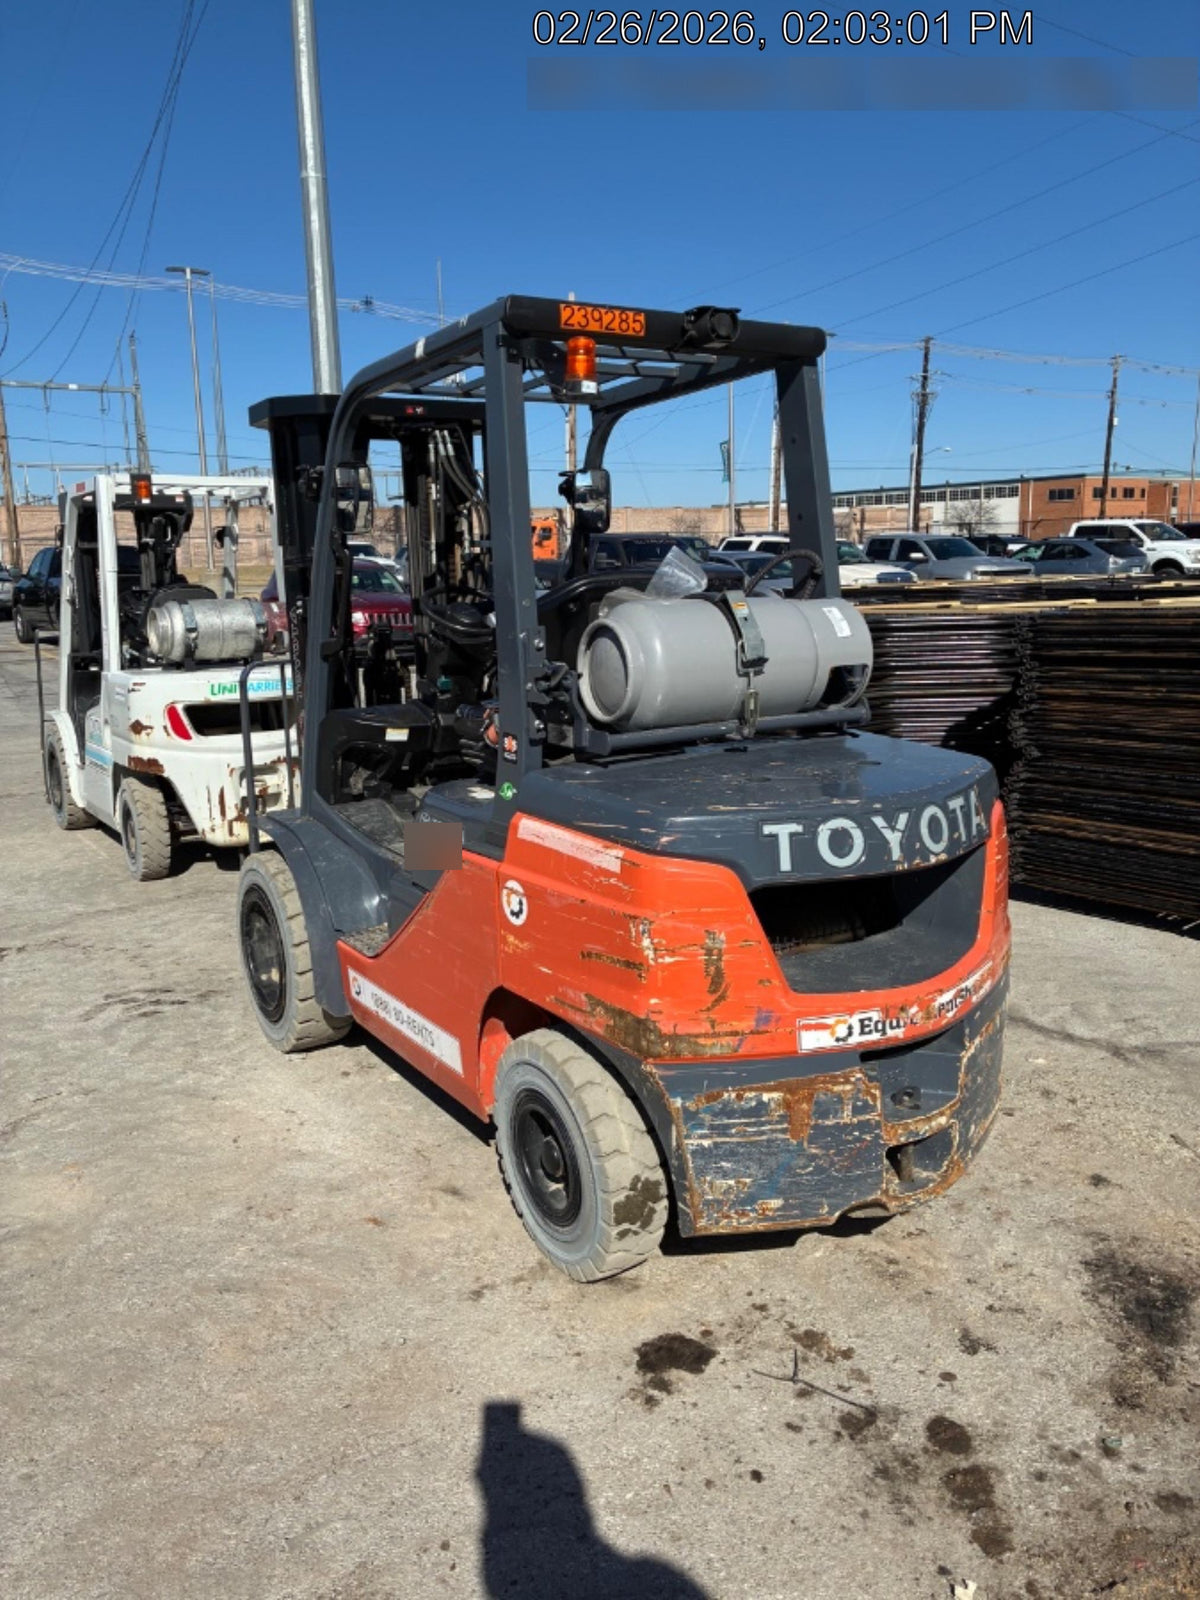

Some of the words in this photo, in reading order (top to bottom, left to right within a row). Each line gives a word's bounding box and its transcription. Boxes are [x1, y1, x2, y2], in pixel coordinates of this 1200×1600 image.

[562, 305, 645, 334] 239285
[210, 678, 294, 696] UNIARRIES
[762, 788, 989, 873] TOYOTA
